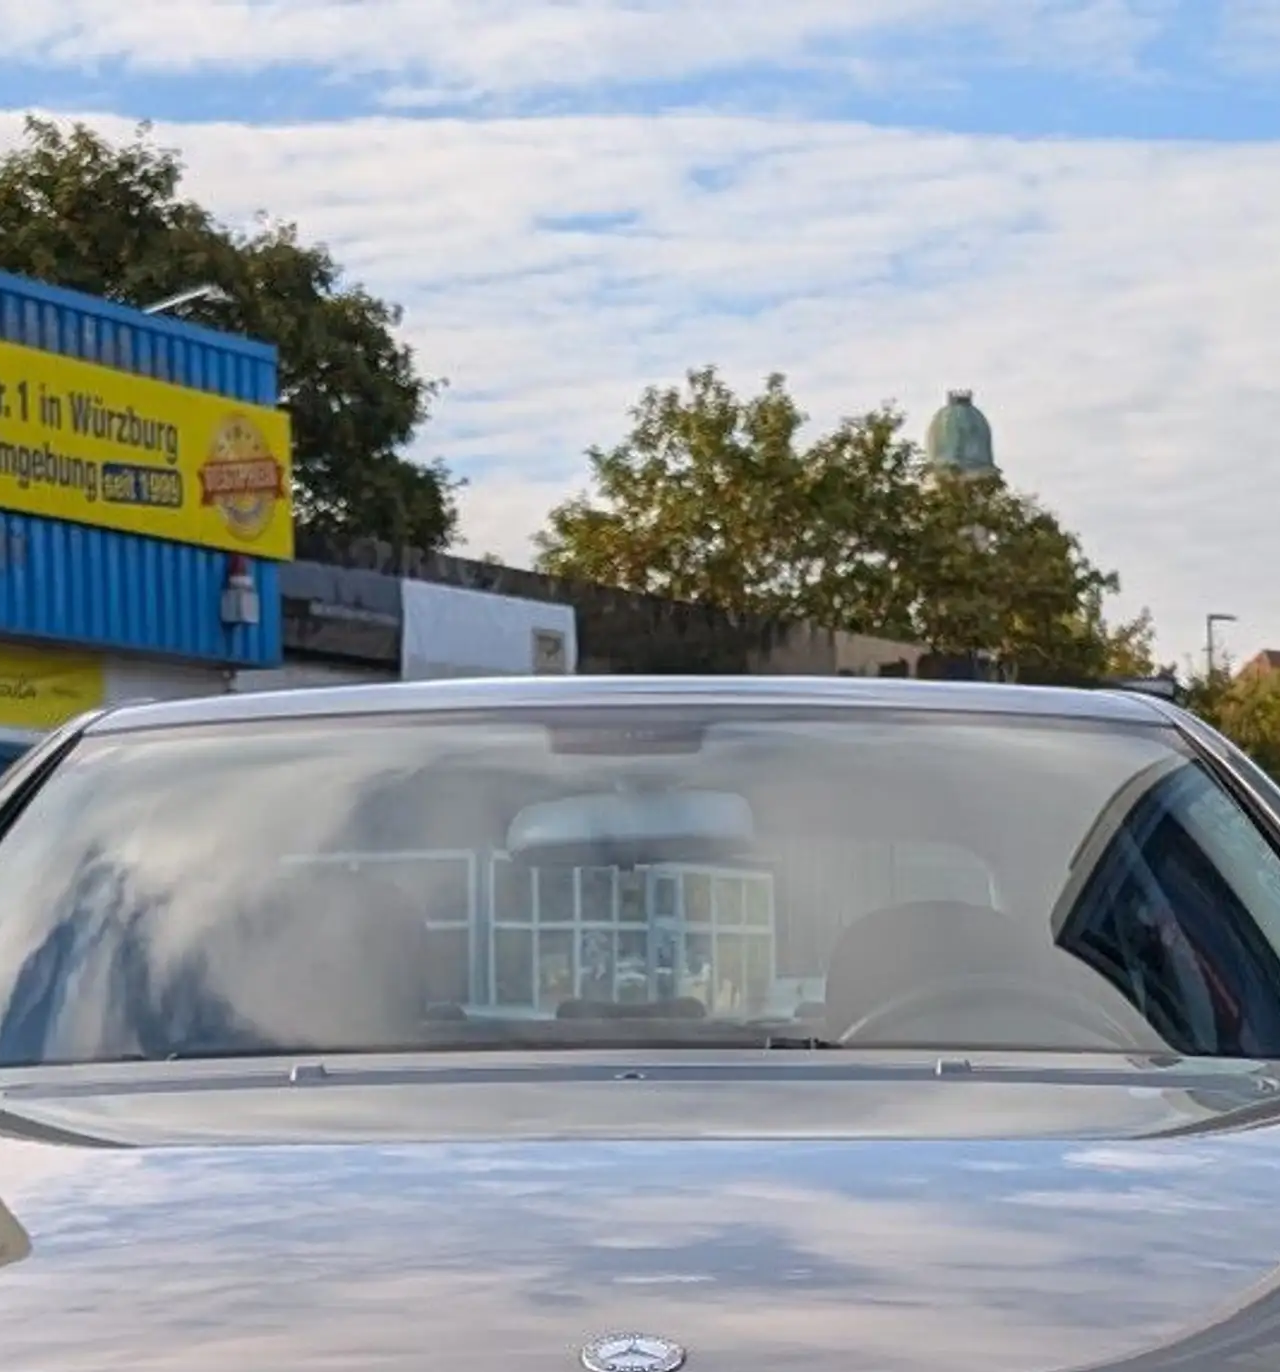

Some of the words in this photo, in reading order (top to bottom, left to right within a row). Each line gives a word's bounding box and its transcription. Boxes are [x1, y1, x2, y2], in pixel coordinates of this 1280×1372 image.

[19, 381, 29, 421] 1
[40, 384, 62, 430] in
[68, 391, 179, 465] Würzburg
